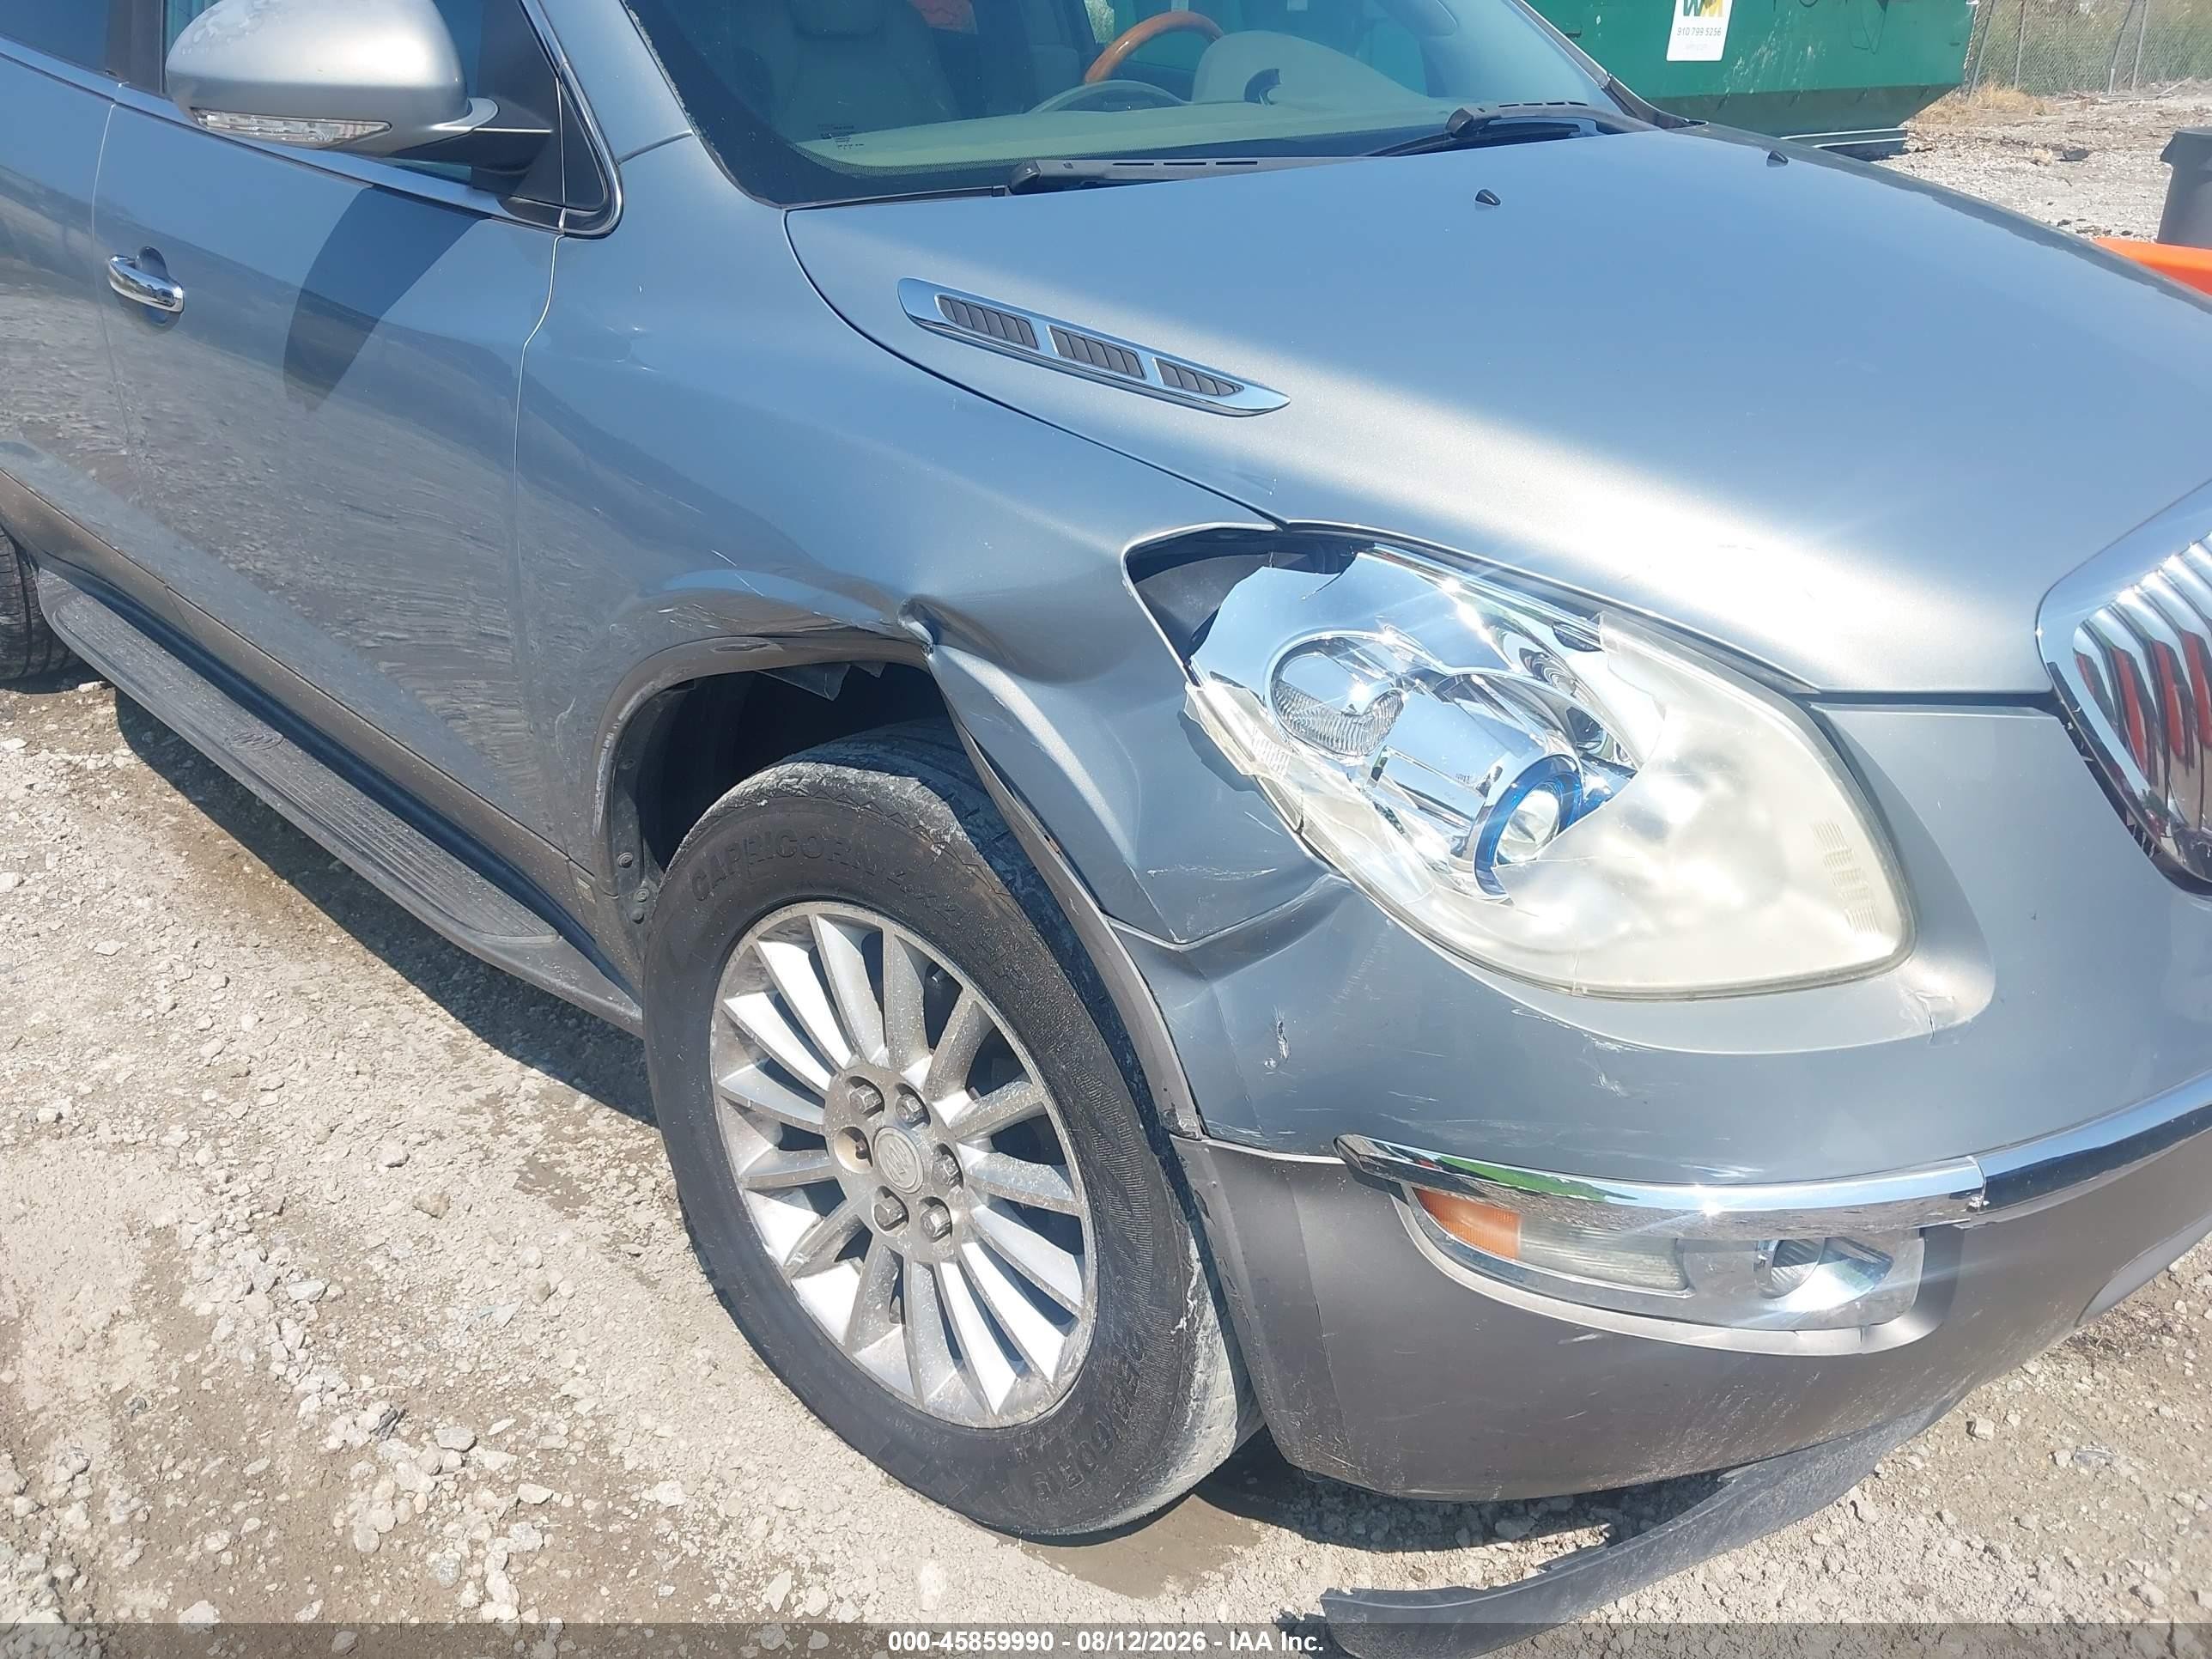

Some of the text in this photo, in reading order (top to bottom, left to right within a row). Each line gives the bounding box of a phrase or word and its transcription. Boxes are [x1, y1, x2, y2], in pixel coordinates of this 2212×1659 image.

[1683, 0, 1723, 17] WM
[1676, 27, 1722, 36] 910 799 5256
